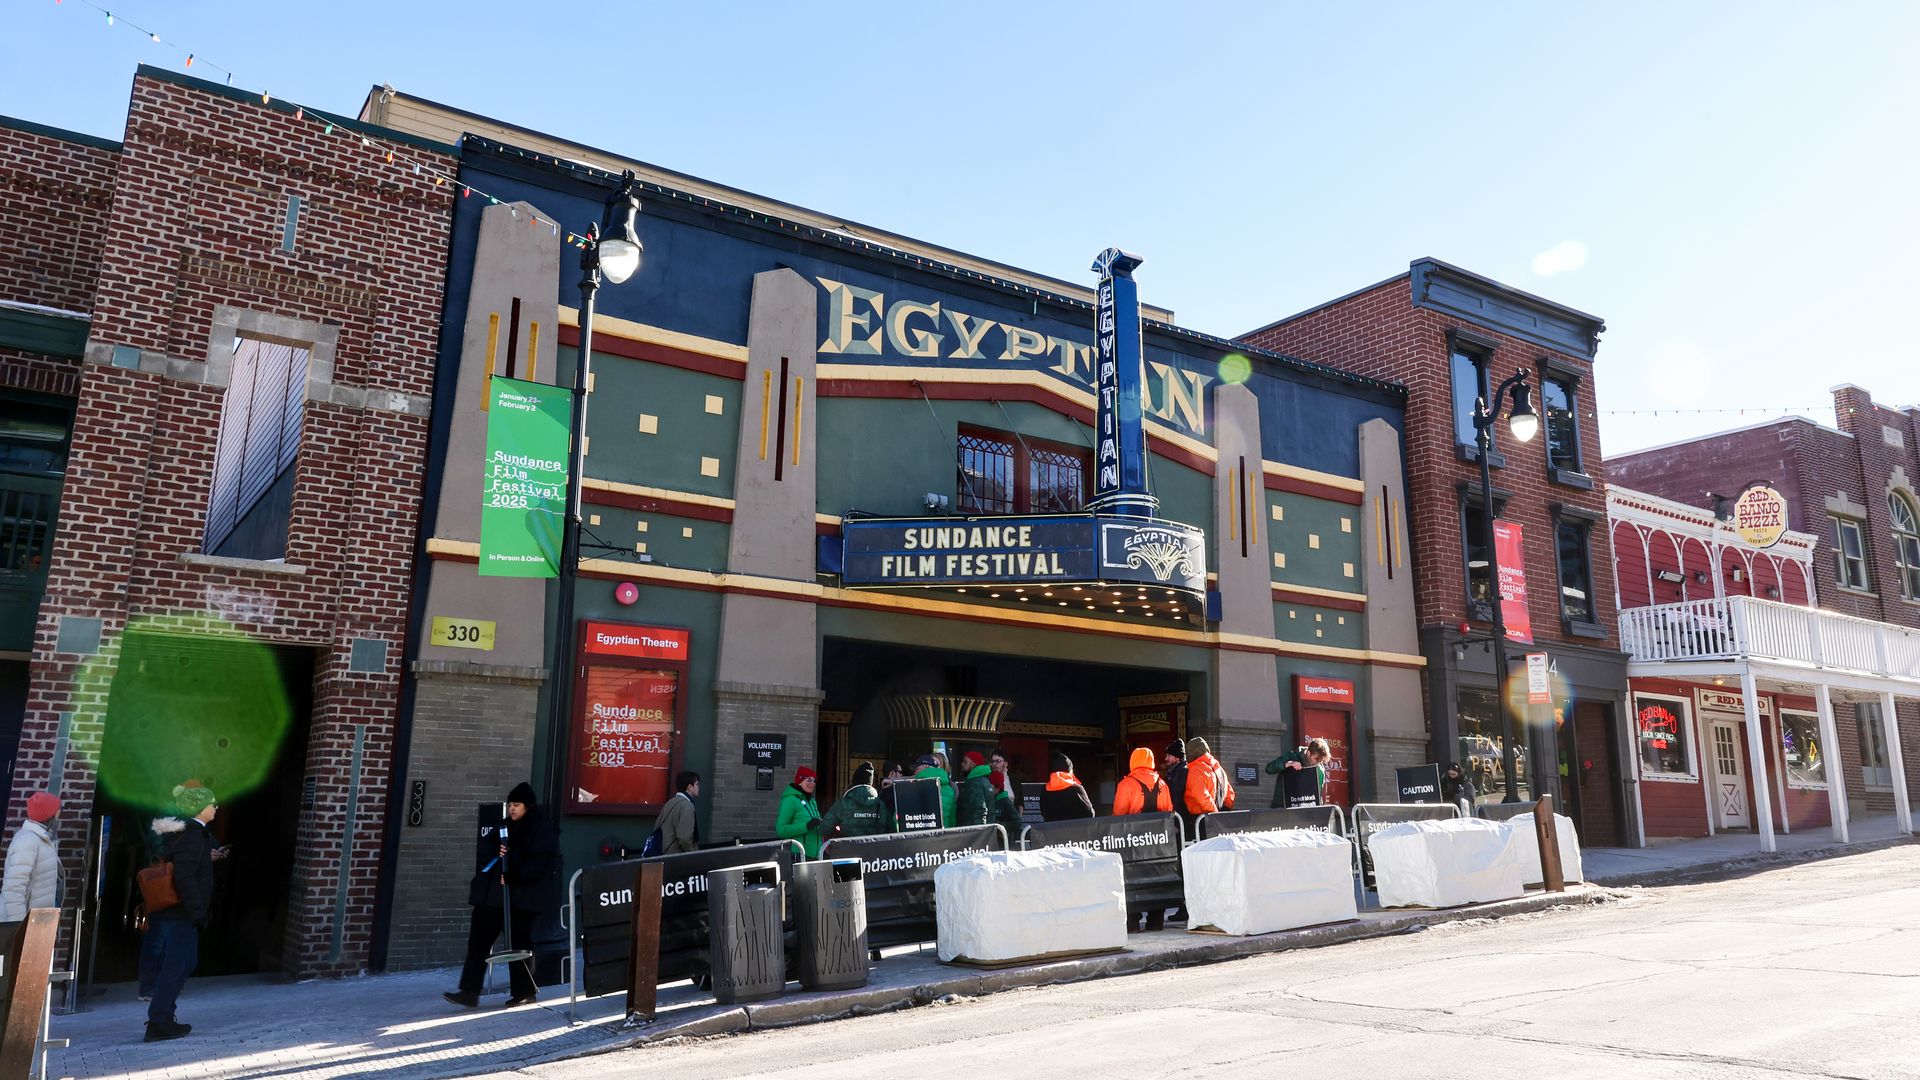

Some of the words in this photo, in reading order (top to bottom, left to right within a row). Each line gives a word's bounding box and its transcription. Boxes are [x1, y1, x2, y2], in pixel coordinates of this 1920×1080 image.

[816, 276, 1213, 436] EGYPTN
[1100, 285, 1118, 490] EGYPTIAN
[499, 392, 528, 403] January
[498, 400, 530, 411] February
[494, 450, 561, 469] Sundance
[494, 464, 528, 479] Film
[492, 479, 558, 498] Festival
[491, 493, 528, 507] 2025
[1748, 491, 1769, 502] RED
[1739, 502, 1781, 516] BANJO
[1739, 515, 1781, 529] PIZZA
[904, 526, 1032, 549] SUNDANCE
[1124, 532, 1192, 556] EGYPTIAN
[497, 554, 520, 562] Person
[881, 555, 936, 577] FILM
[946, 553, 1064, 576] FESTIVAL
[447, 625, 480, 642] 330
[596, 633, 640, 646] Egyptian
[641, 636, 679, 649] Theatre
[1549, 658, 1558, 678] 4
[1304, 684, 1329, 694] Egyptian
[1328, 686, 1349, 696] Theatre
[1716, 695, 1735, 705] RED
[593, 703, 663, 718] Sundance
[593, 719, 628, 733] Film
[591, 735, 659, 750] Festival
[748, 742, 782, 750] VOLUNTEER
[1305, 734, 1342, 747] Snce
[1476, 734, 1503, 750] PAR
[589, 751, 625, 765] 2025
[1402, 784, 1434, 795] CAUTION
[410, 781, 424, 826] 330
[922, 812, 936, 820] block
[1102, 835, 1126, 850] film
[1126, 830, 1169, 847] festival
[862, 857, 913, 874] ndance
[915, 851, 942, 868] film
[600, 880, 685, 906] sunce
[687, 874, 708, 893] fil
